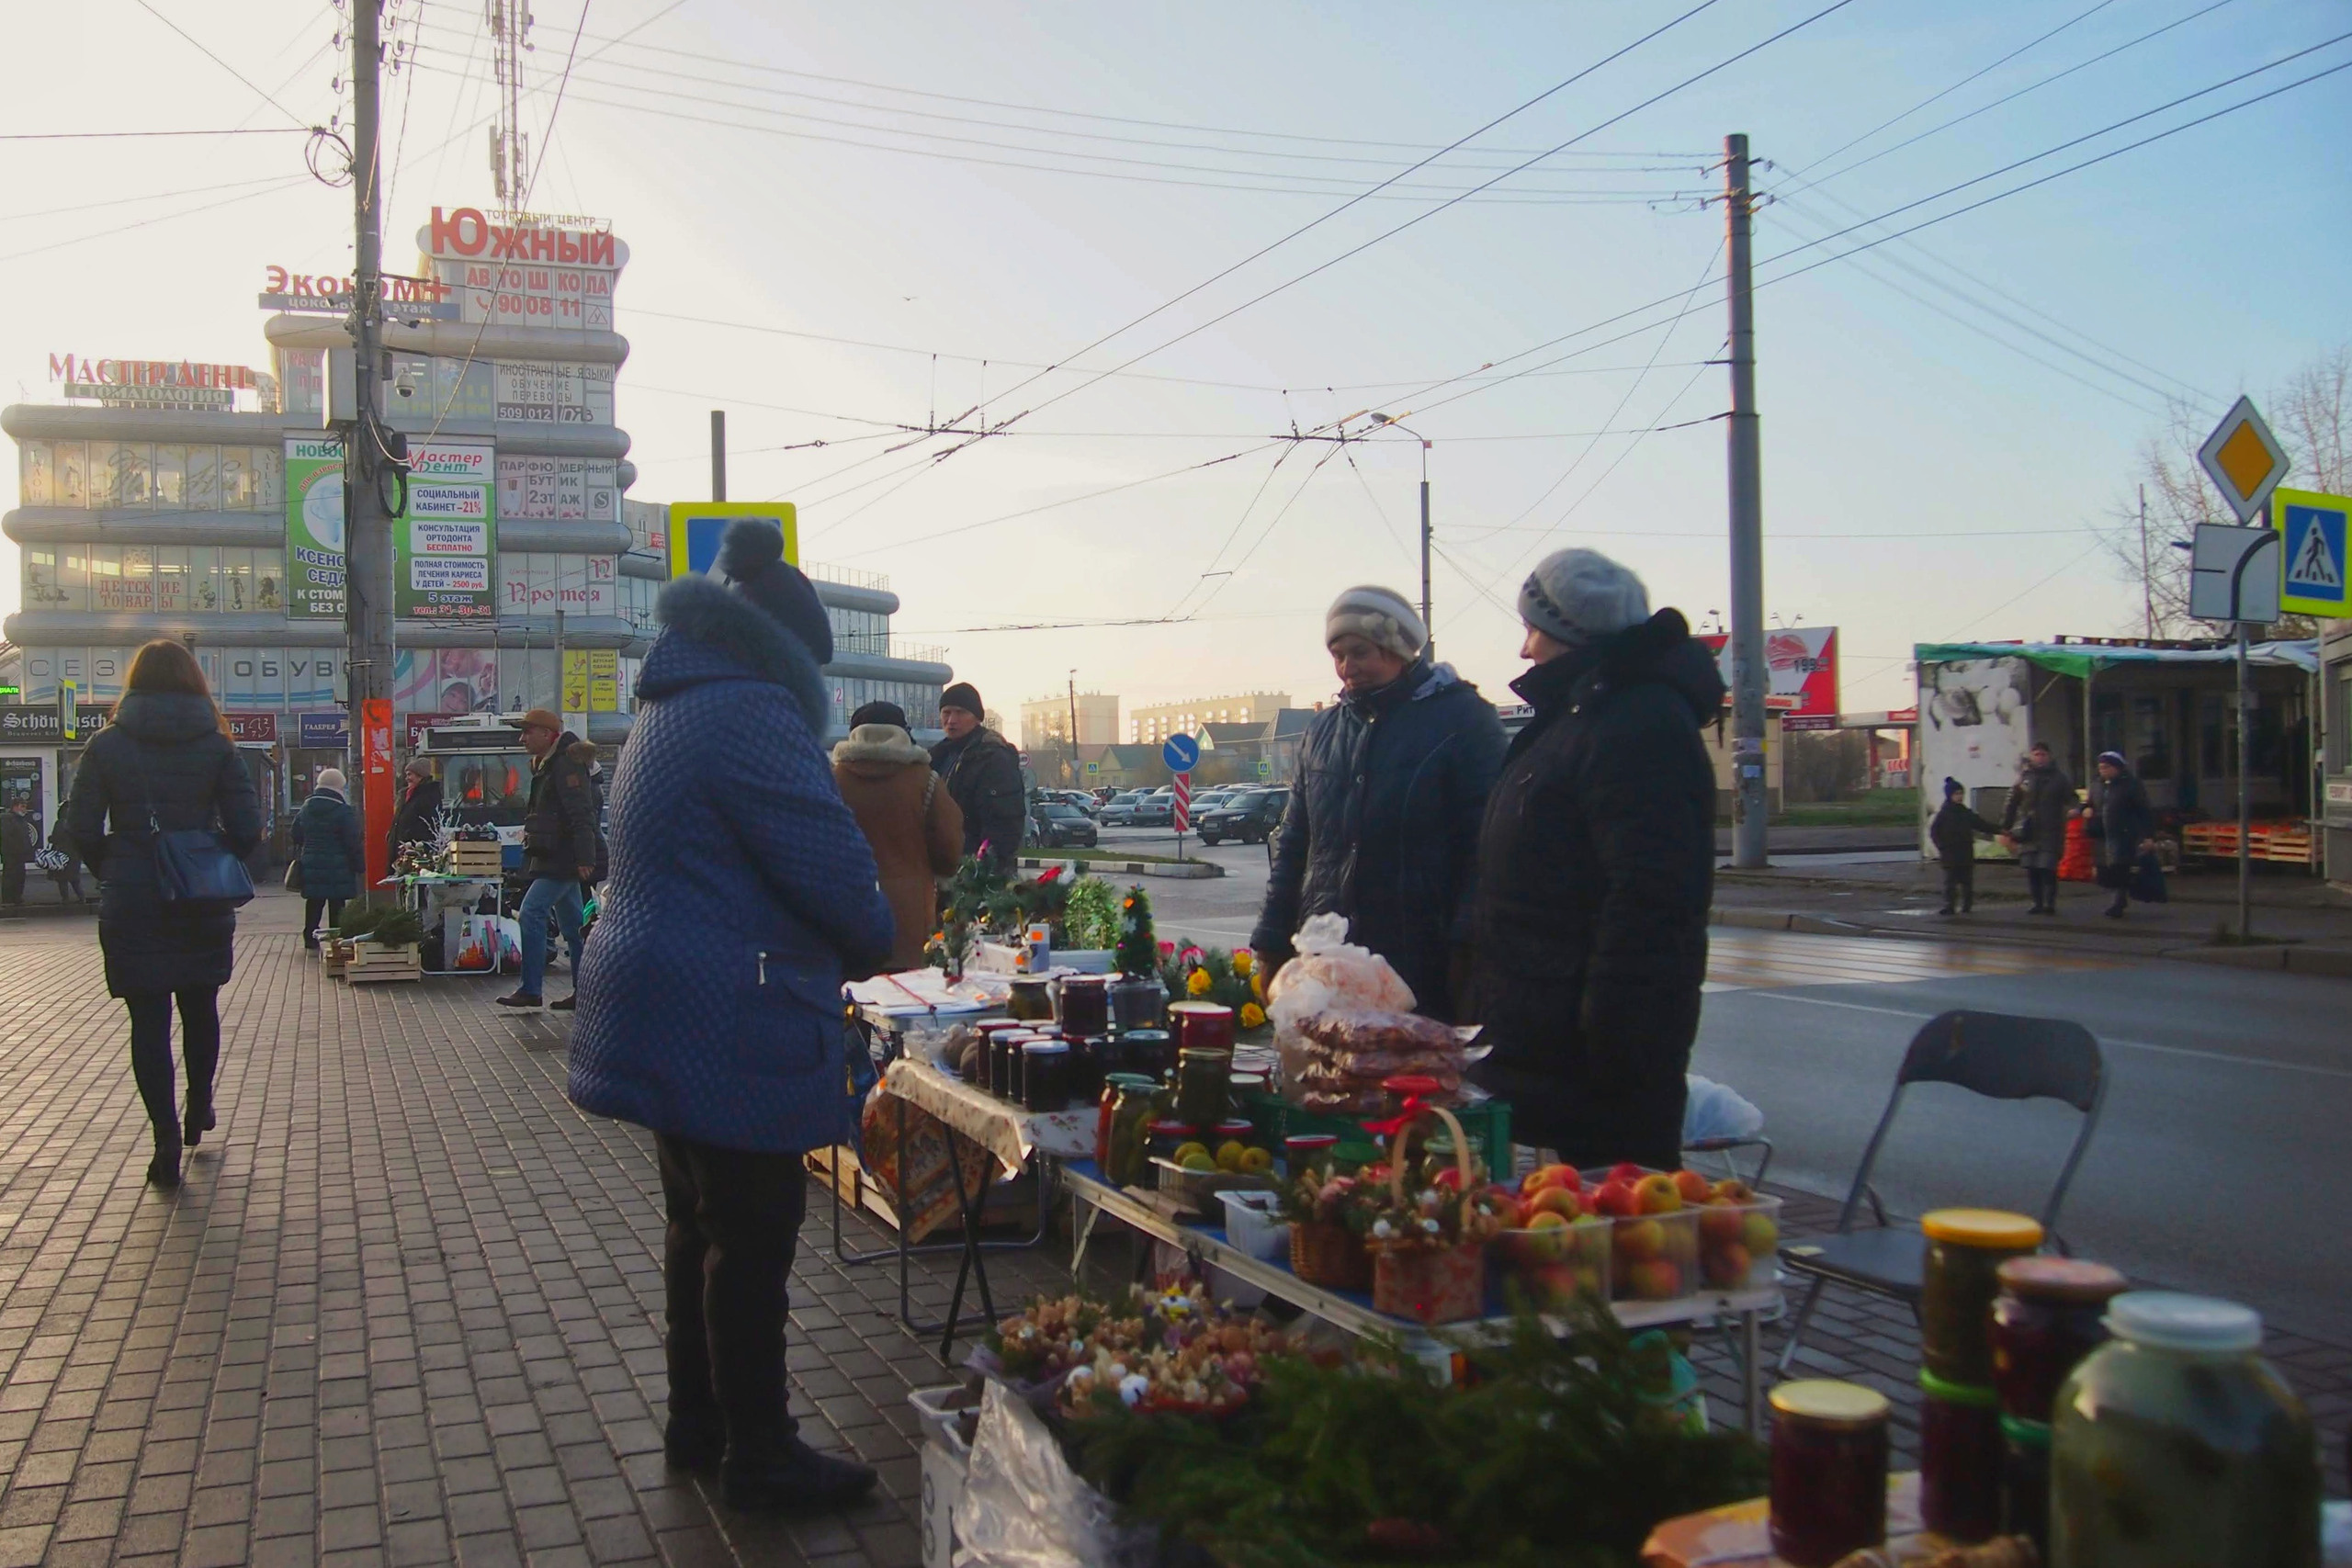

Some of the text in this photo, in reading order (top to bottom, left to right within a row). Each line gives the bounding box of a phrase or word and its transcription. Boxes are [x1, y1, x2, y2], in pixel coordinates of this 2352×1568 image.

[486, 209, 596, 224] ТОРГОВЫЙ ЦЕНТР
[467, 267, 608, 294] АВТОШКОЛА
[393, 304, 432, 314] этаж
[500, 365, 610, 380] ИНОСТРАННЫЕ ЯЗЫКИ
[512, 379, 570, 390] ОБУЧЕНИЕ
[74, 386, 226, 402] СТОМАТОЛОГИЯ
[513, 391, 571, 403] ПЕРЕВОДЫ
[500, 461, 613, 474] ПАРФЮМЕРНЫЙ
[529, 476, 578, 487] БУТИК
[417, 489, 480, 499] СОЦИАЛЬНЫЙ
[416, 502, 456, 512] КАБИНЕТ
[418, 525, 480, 534] КОНСУЛЬТАЦИЯ
[426, 535, 472, 543] ОРТОДОНТА
[426, 544, 472, 552] БЕСПЛАТНО
[100, 580, 180, 595] ДЕТСКИЕ
[423, 579, 445, 588] ДЕТЕЙ
[100, 594, 173, 607] ТОВАРЫ
[429, 592, 473, 603] 5 этаж
[311, 603, 334, 613] БЕЗ
